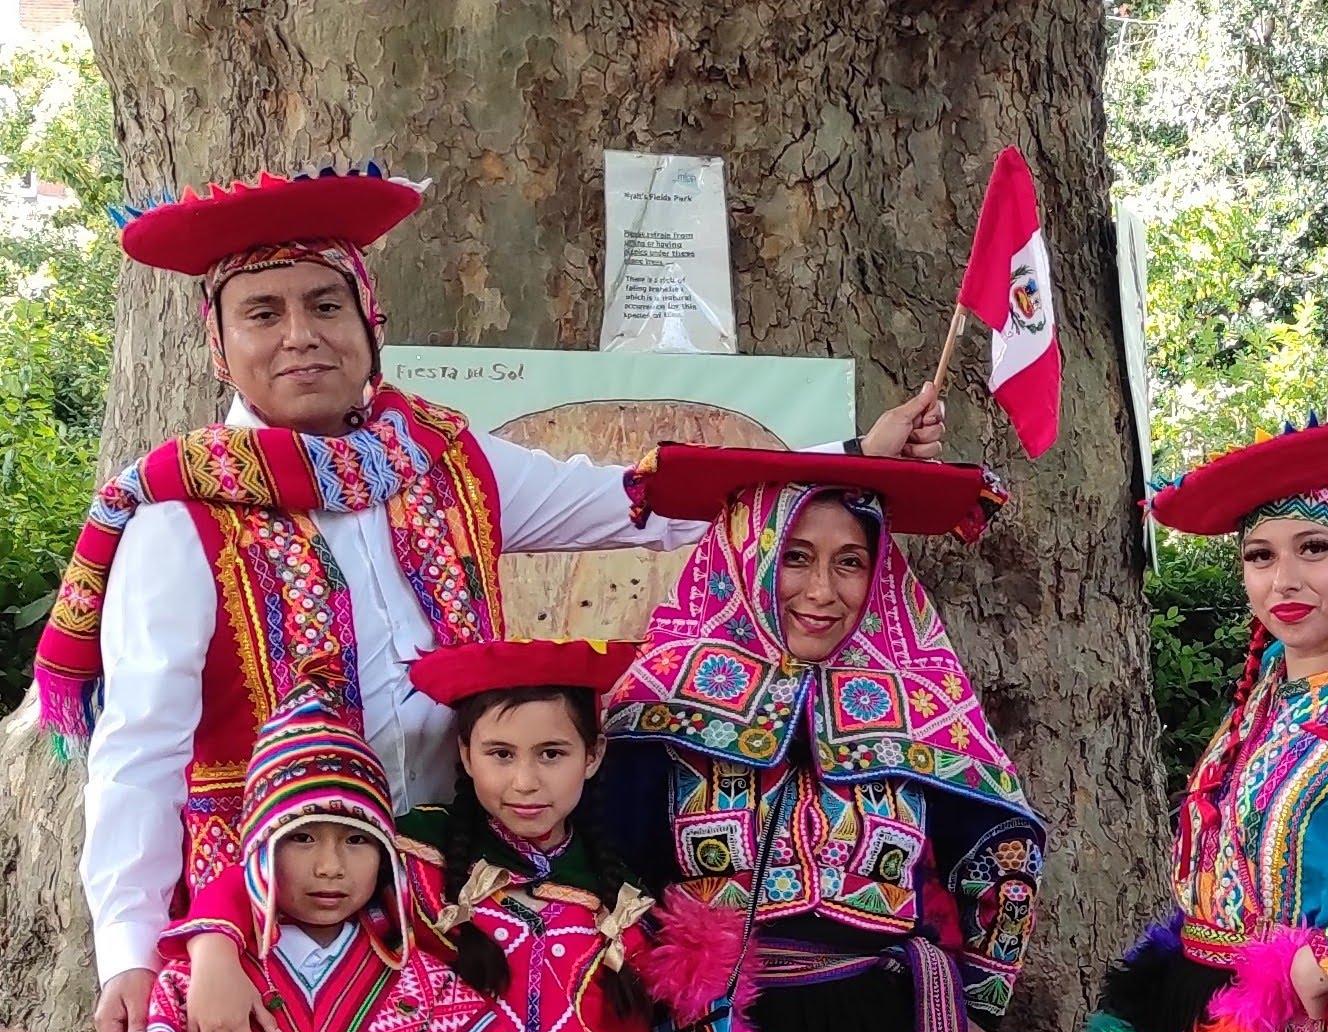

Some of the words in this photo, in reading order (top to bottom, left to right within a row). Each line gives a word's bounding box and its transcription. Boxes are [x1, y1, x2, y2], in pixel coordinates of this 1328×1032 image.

[649, 193, 672, 202] Fields
[674, 194, 692, 202] Park
[656, 240, 683, 249] having
[672, 249, 695, 257] these
[626, 275, 645, 283] There
[625, 284, 647, 293] falling
[625, 293, 646, 301] which
[668, 302, 679, 310] for
[681, 302, 697, 310] this
[623, 311, 649, 319] species
[487, 362, 525, 381] Sol
